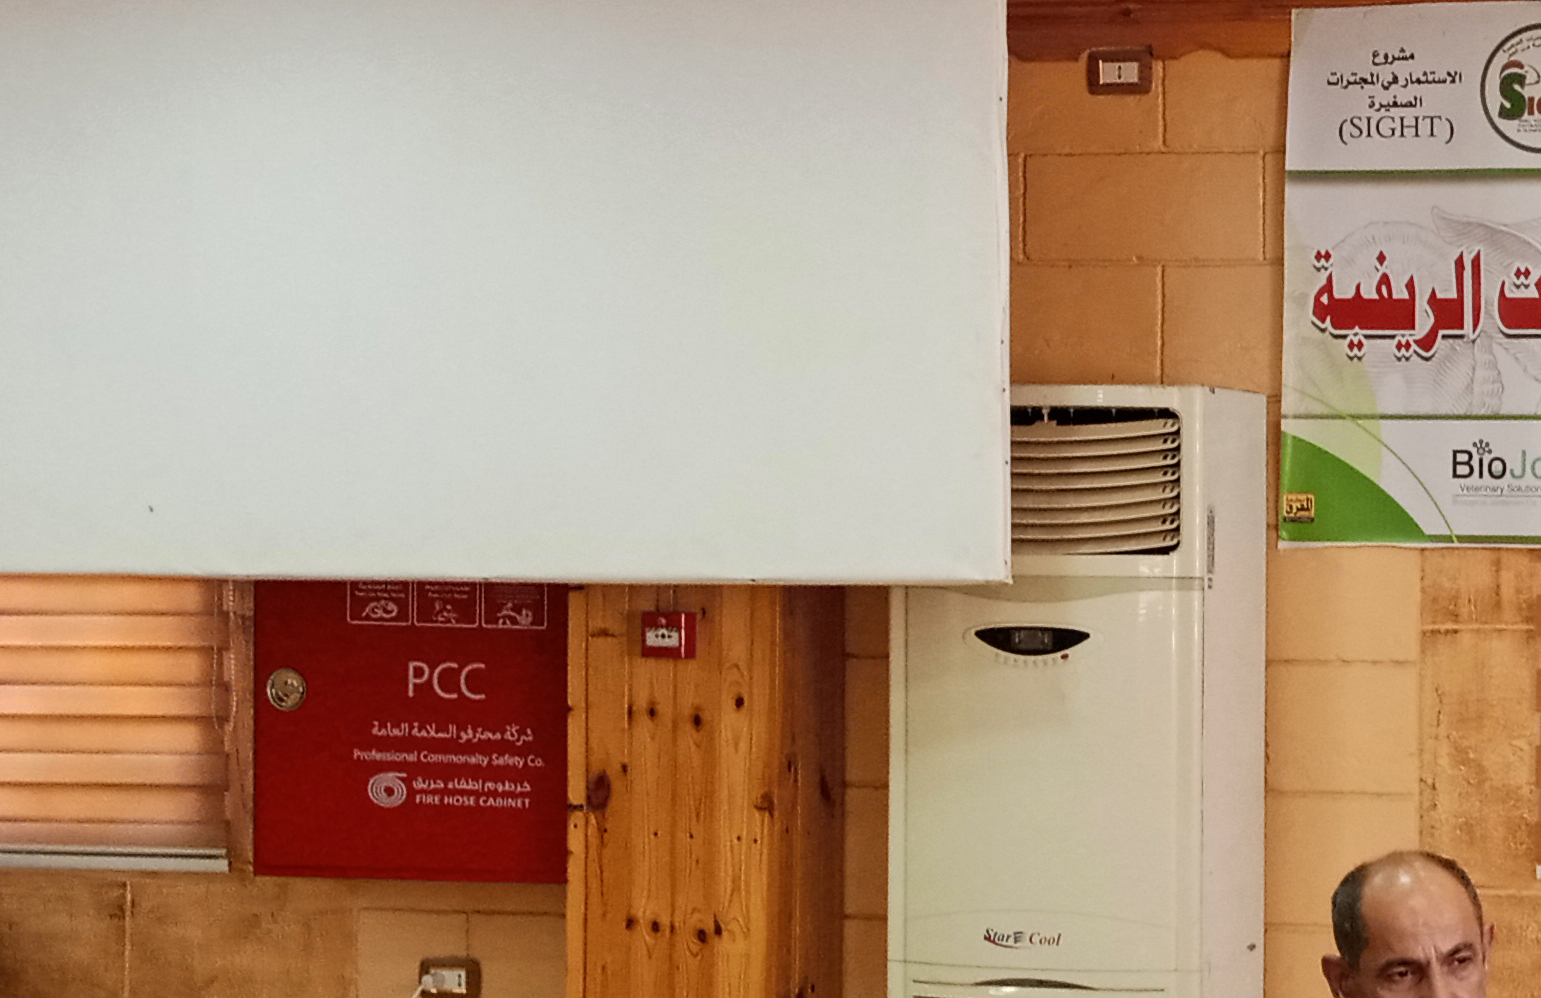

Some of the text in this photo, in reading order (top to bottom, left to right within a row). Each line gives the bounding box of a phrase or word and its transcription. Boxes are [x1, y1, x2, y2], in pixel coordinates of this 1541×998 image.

[1372, 47, 1415, 66] مشروع
[1327, 71, 1462, 90] الاستثمار في المجترات
[1368, 95, 1422, 112] الصغيرة
[1338, 115, 1454, 145] (SIGHT)
[1310, 248, 1483, 358] الريفية
[1459, 483, 1505, 496] Veterinary
[408, 661, 486, 700] PCC
[371, 720, 409, 737] العامة
[411, 721, 457, 739] السلامة
[503, 723, 534, 746] شركة
[353, 748, 417, 761] Professional
[492, 753, 525, 769] Safety
[527, 754, 545, 767] Co.
[412, 775, 445, 789] حريق
[484, 779, 531, 793] خرطوم
[415, 793, 531, 808] FIRE HOSE CABINET
[1029, 932, 1062, 946] Cool
